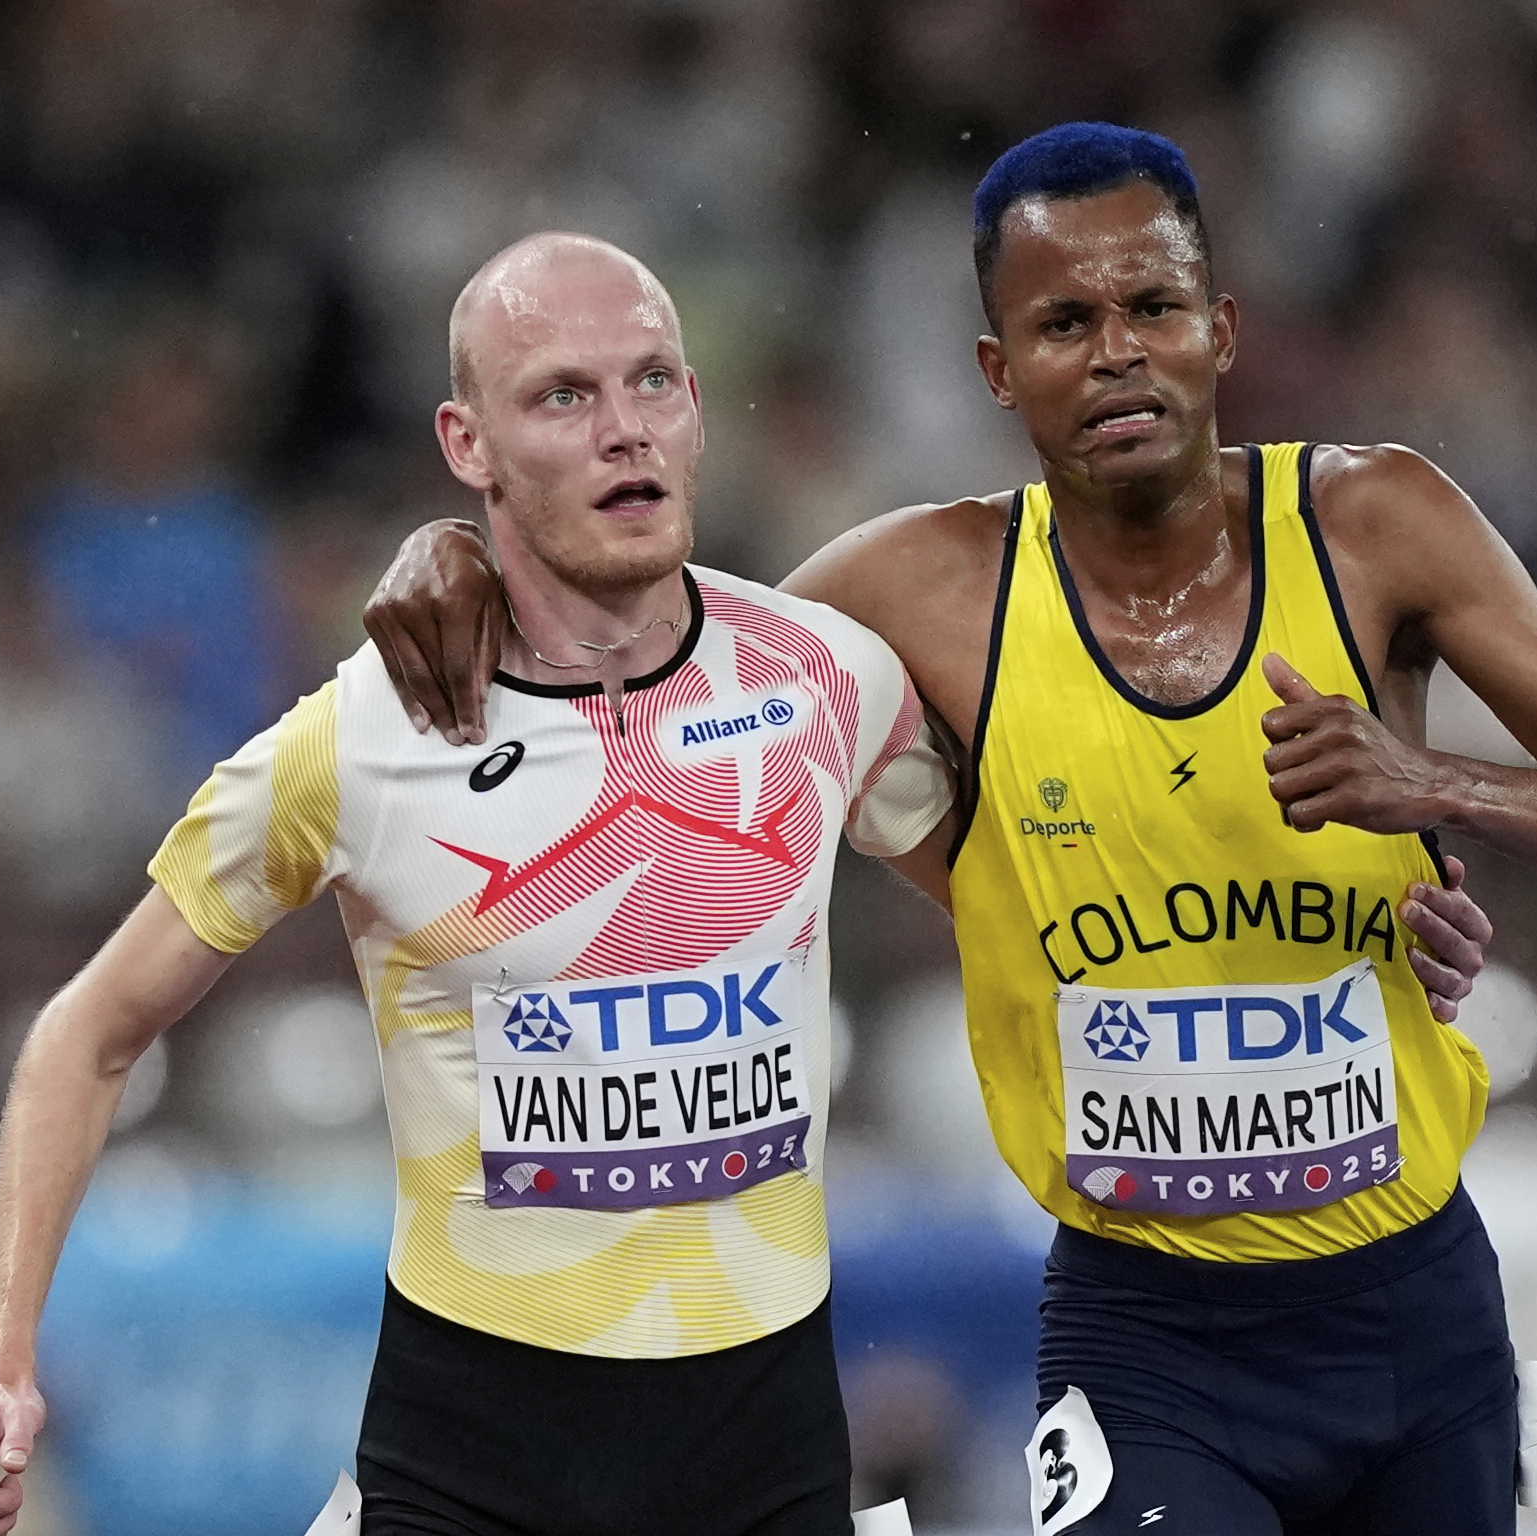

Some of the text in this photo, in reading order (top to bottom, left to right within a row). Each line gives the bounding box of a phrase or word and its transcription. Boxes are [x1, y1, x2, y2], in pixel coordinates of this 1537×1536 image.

[681, 714, 761, 747] Allianz
[1020, 817, 1096, 840] Deporte
[1039, 879, 1395, 985] COLOMBIA
[570, 961, 784, 1053] TDK
[1147, 979, 1368, 1063] TDK
[494, 1043, 799, 1143] VAN DE VELDE
[1081, 1061, 1385, 1154] SAN MARTÍN
[1039, 1428, 1078, 1527] 3
